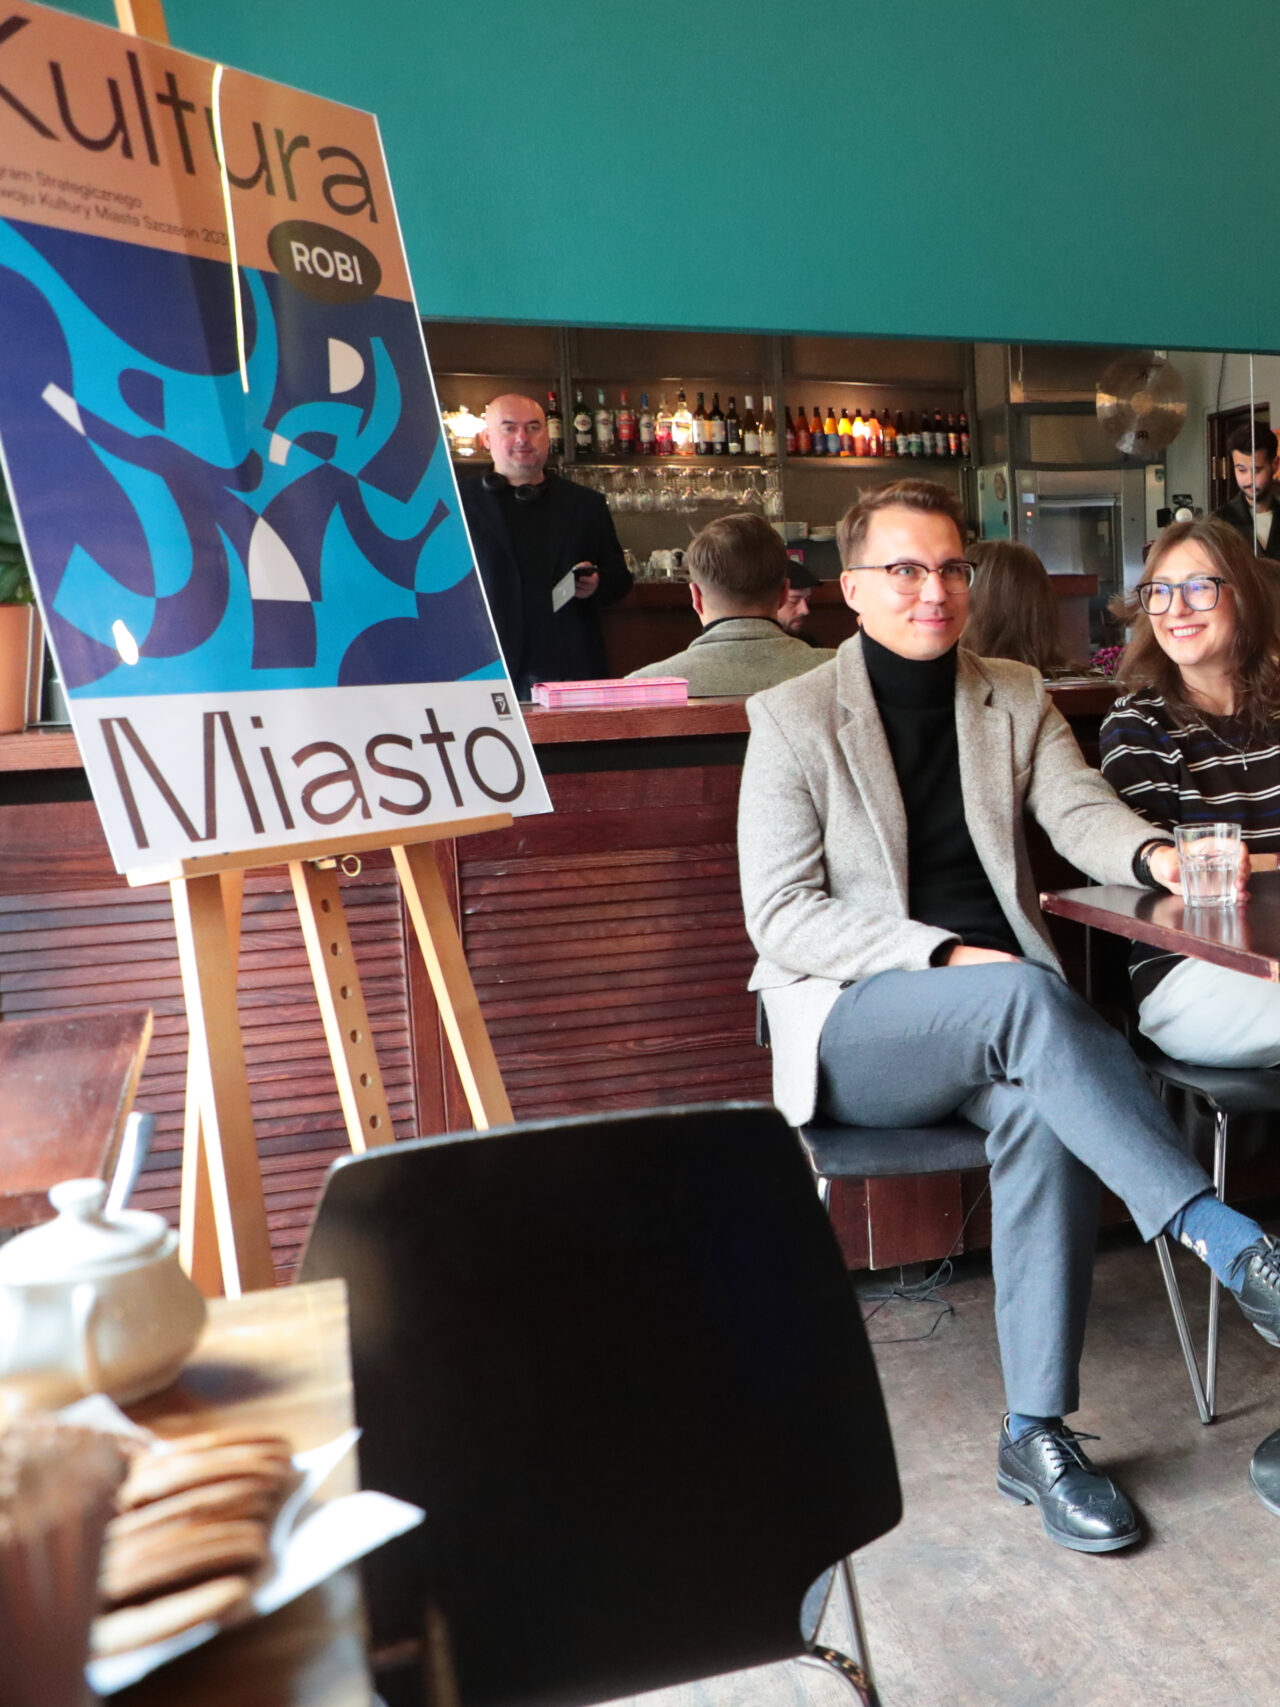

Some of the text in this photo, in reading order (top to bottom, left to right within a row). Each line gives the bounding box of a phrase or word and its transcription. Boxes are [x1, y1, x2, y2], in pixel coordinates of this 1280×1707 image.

[35, 170, 142, 209] Strategicznego
[38, 190, 90, 221] Kultury
[93, 204, 140, 227] Miasta
[290, 241, 363, 285] ROBI
[99, 708, 527, 849] Miasto
